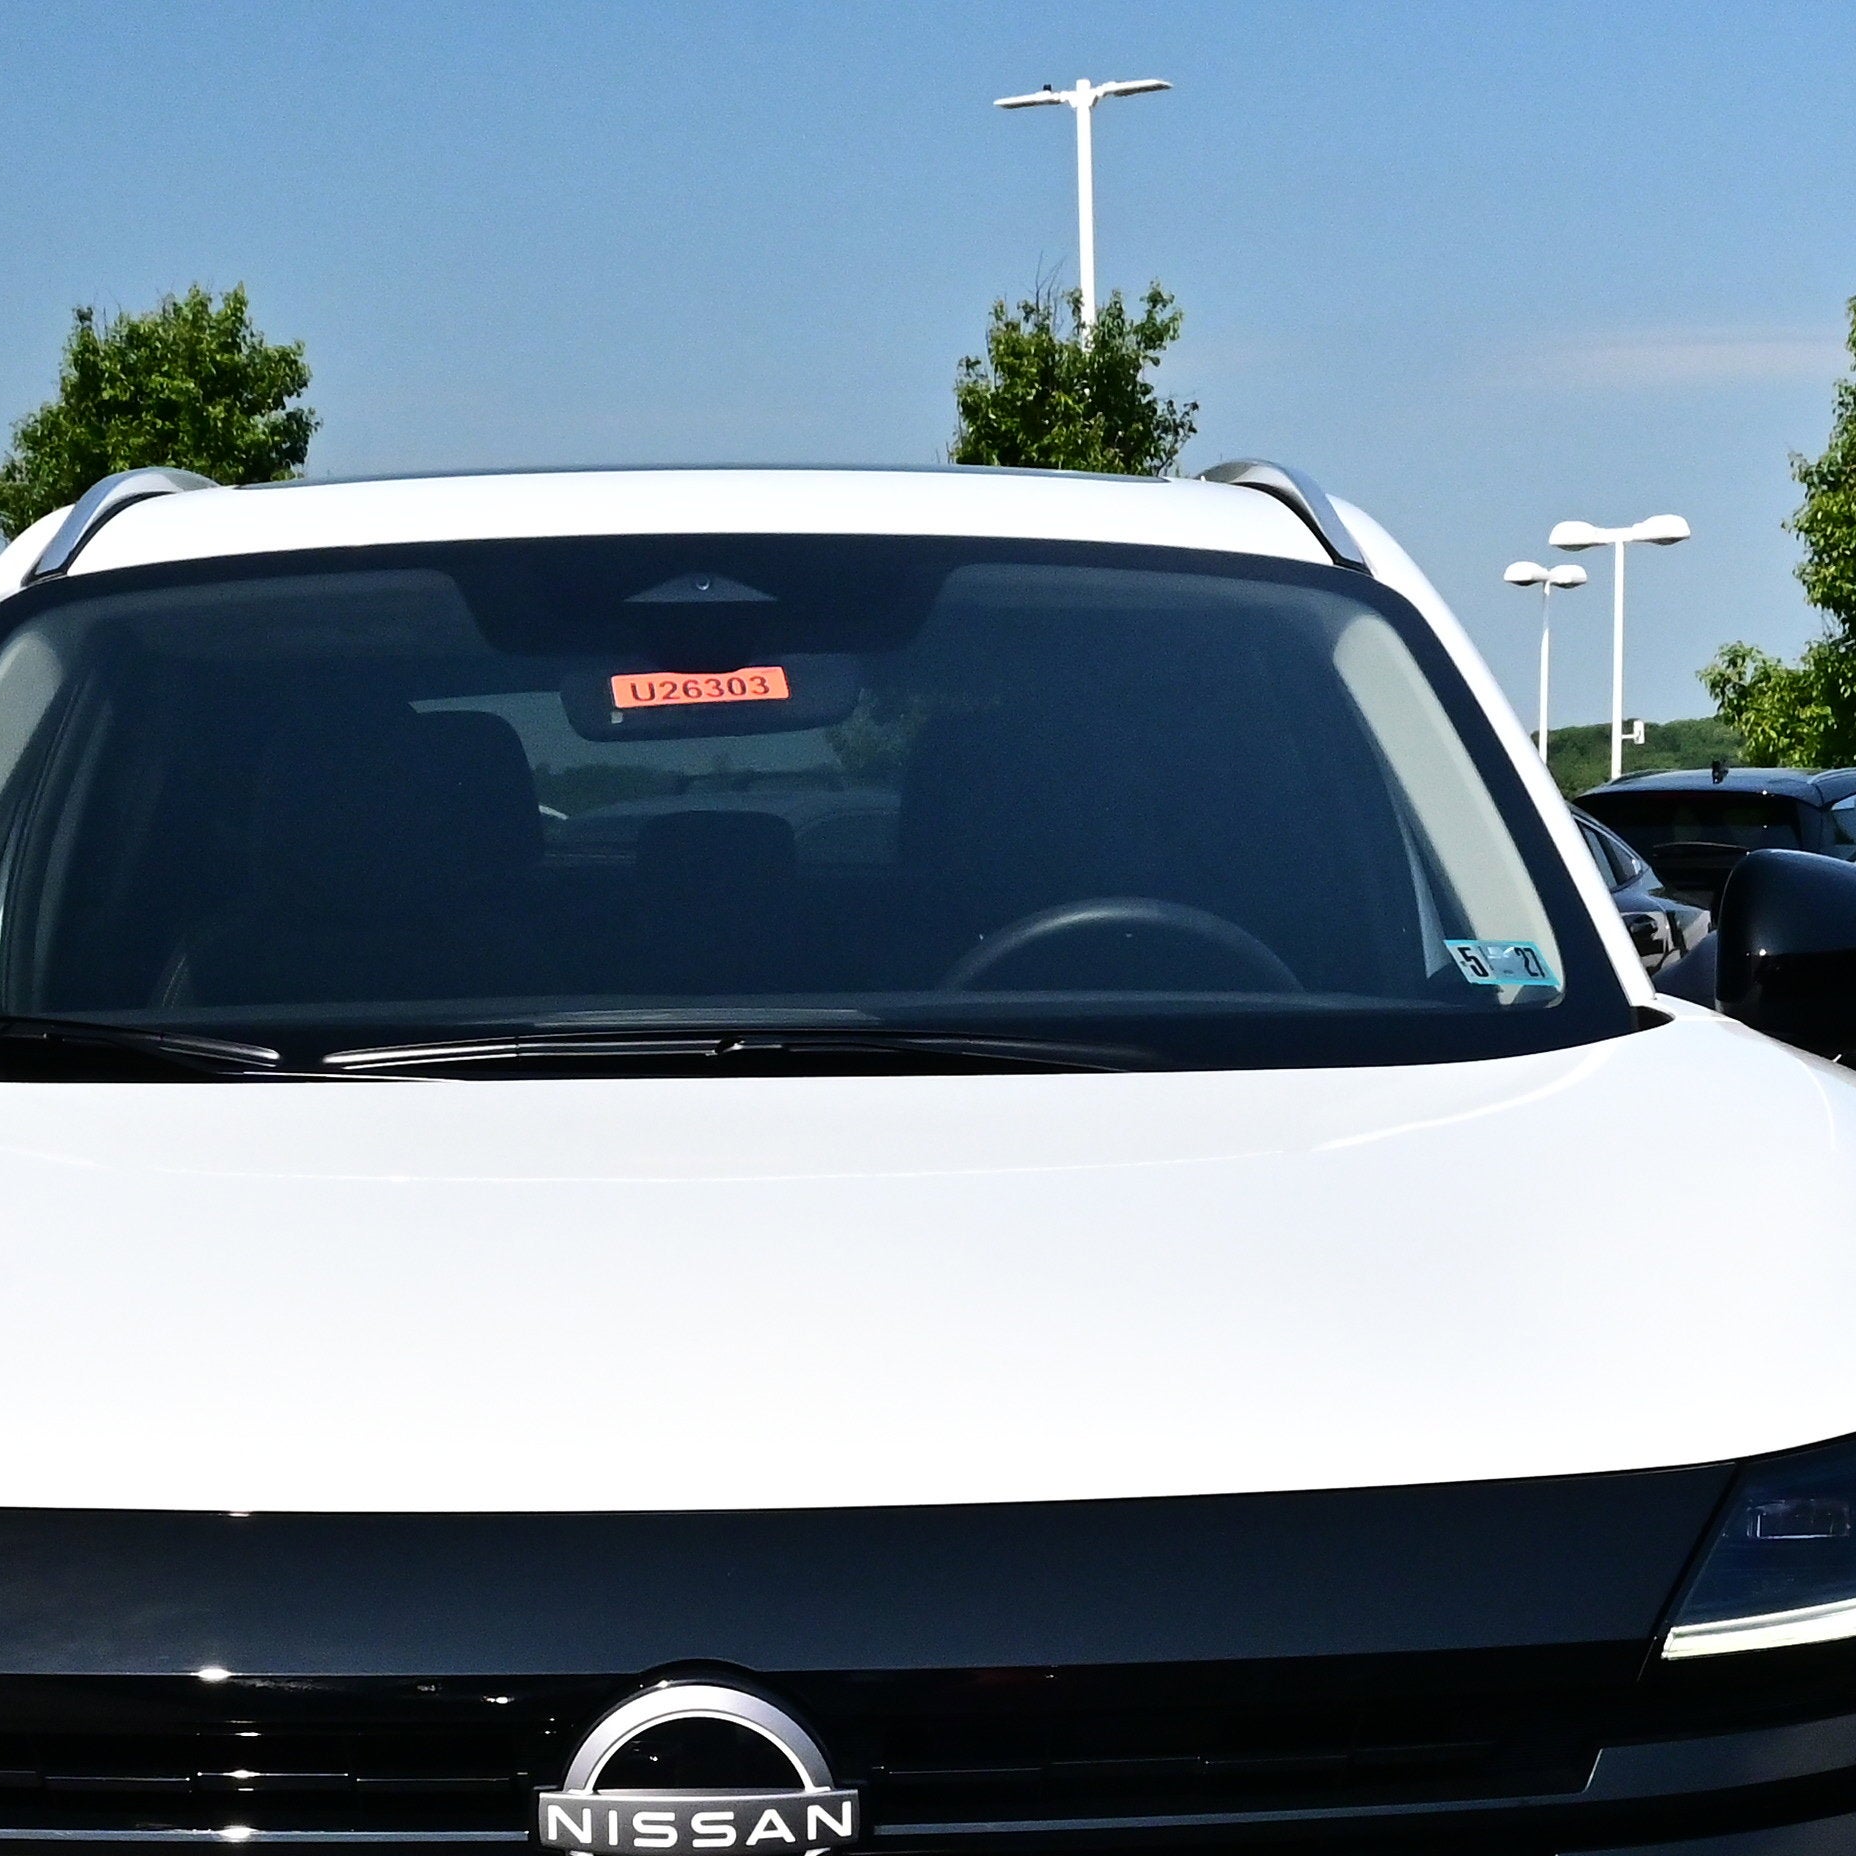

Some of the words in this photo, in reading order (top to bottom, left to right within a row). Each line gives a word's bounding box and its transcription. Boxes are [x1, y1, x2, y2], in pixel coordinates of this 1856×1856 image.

[630, 676, 771, 702] U26303
[1457, 946, 1489, 978] 5
[547, 1800, 852, 1848] NISSAN
